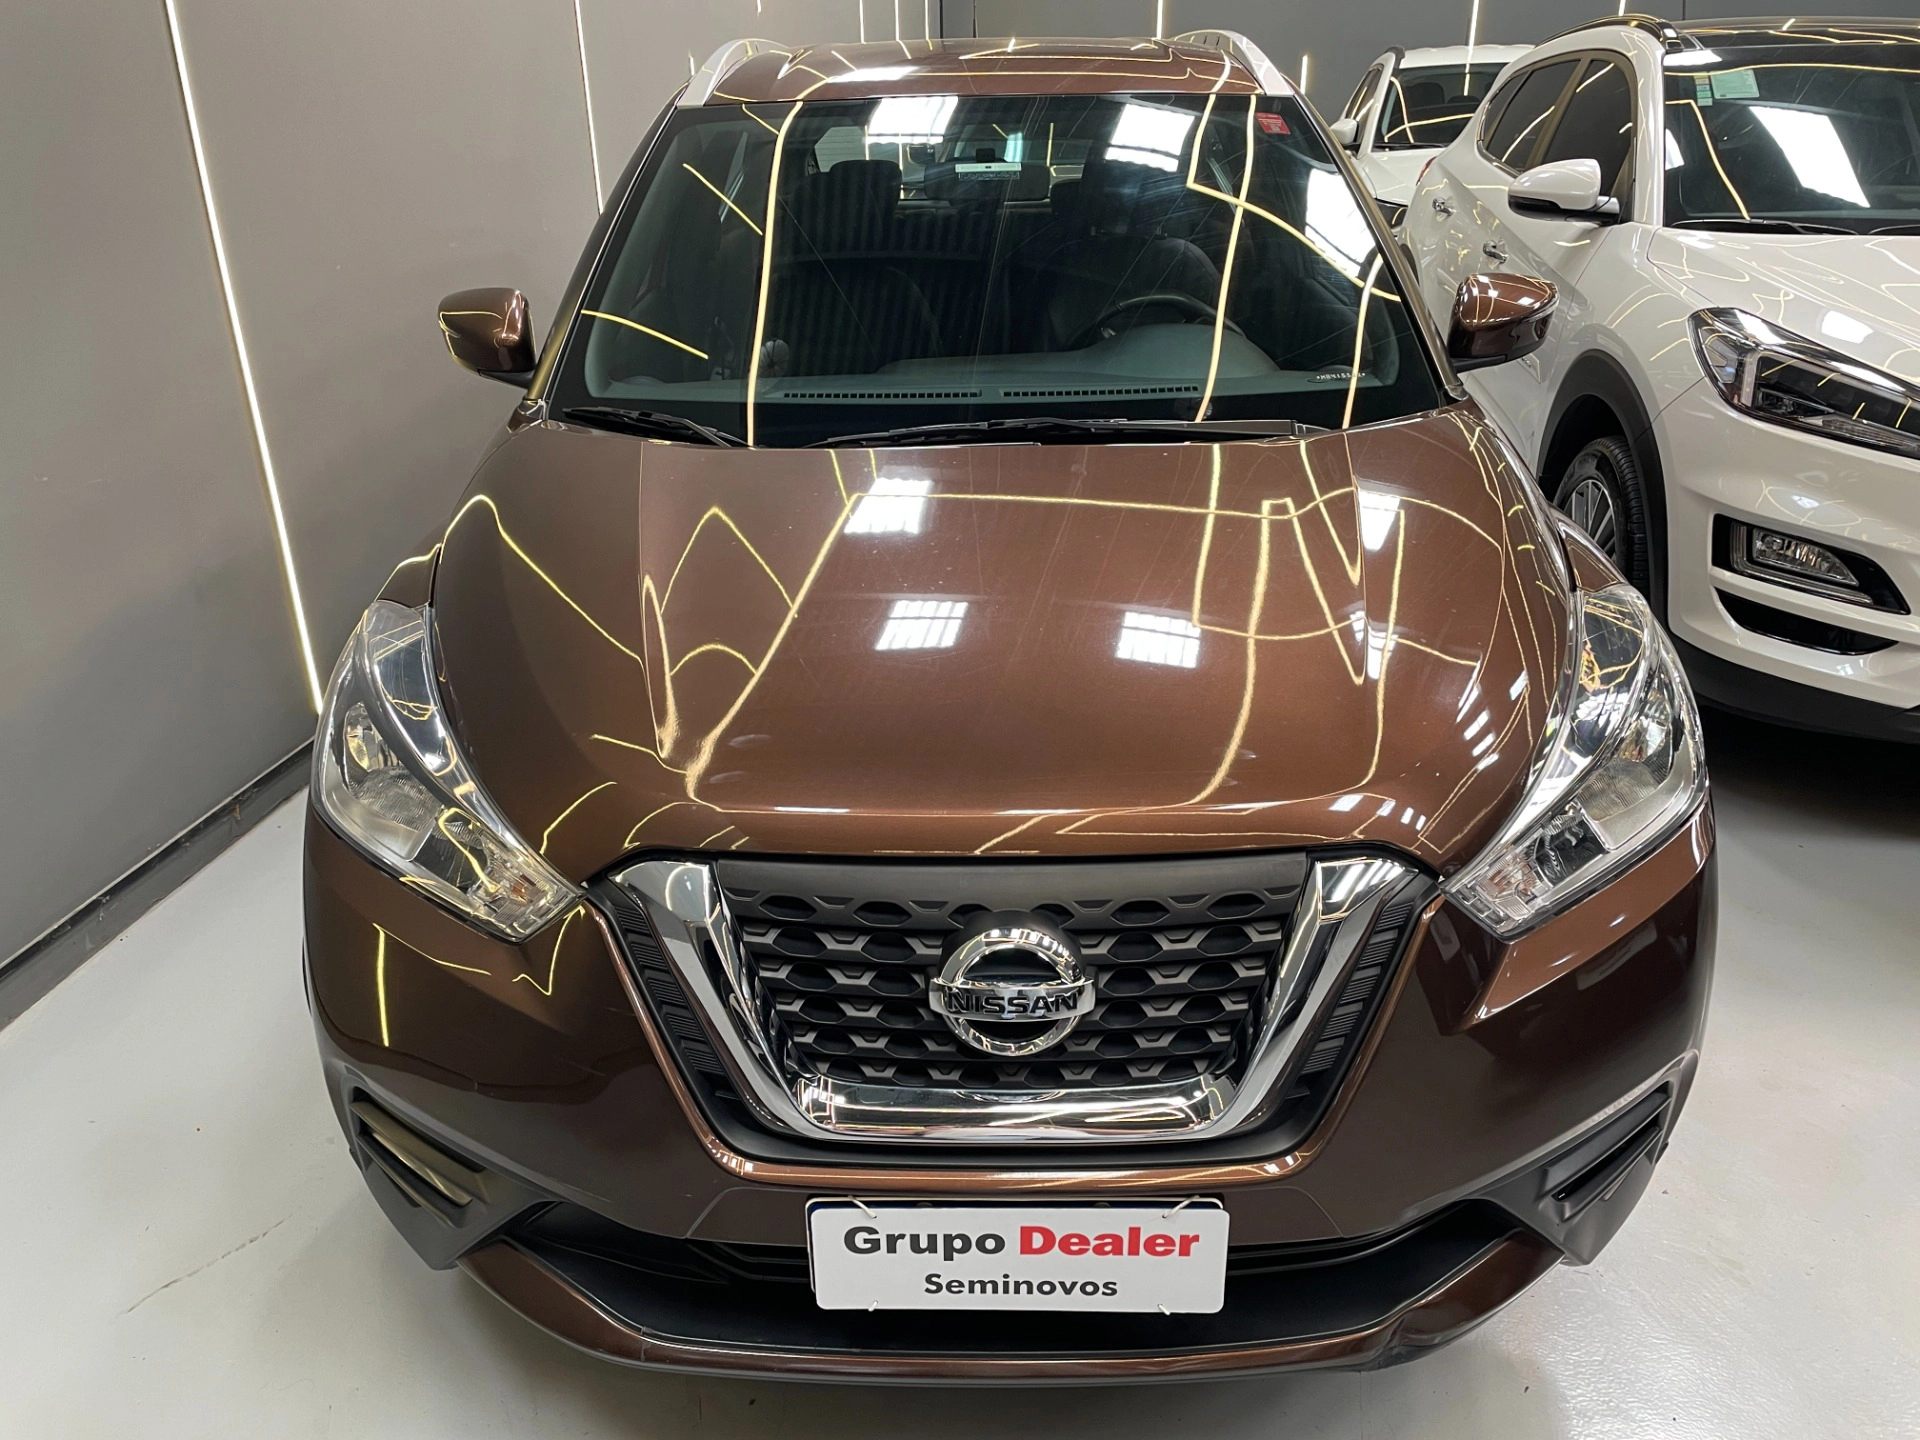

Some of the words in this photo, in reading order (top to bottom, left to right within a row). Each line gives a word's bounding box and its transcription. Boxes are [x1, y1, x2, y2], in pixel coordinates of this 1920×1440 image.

[946, 992, 1080, 1014] NISSAN
[843, 1226, 1006, 1262] Grupo
[1019, 1226, 1200, 1257] Dealer
[924, 1273, 1118, 1297] Seminovos
